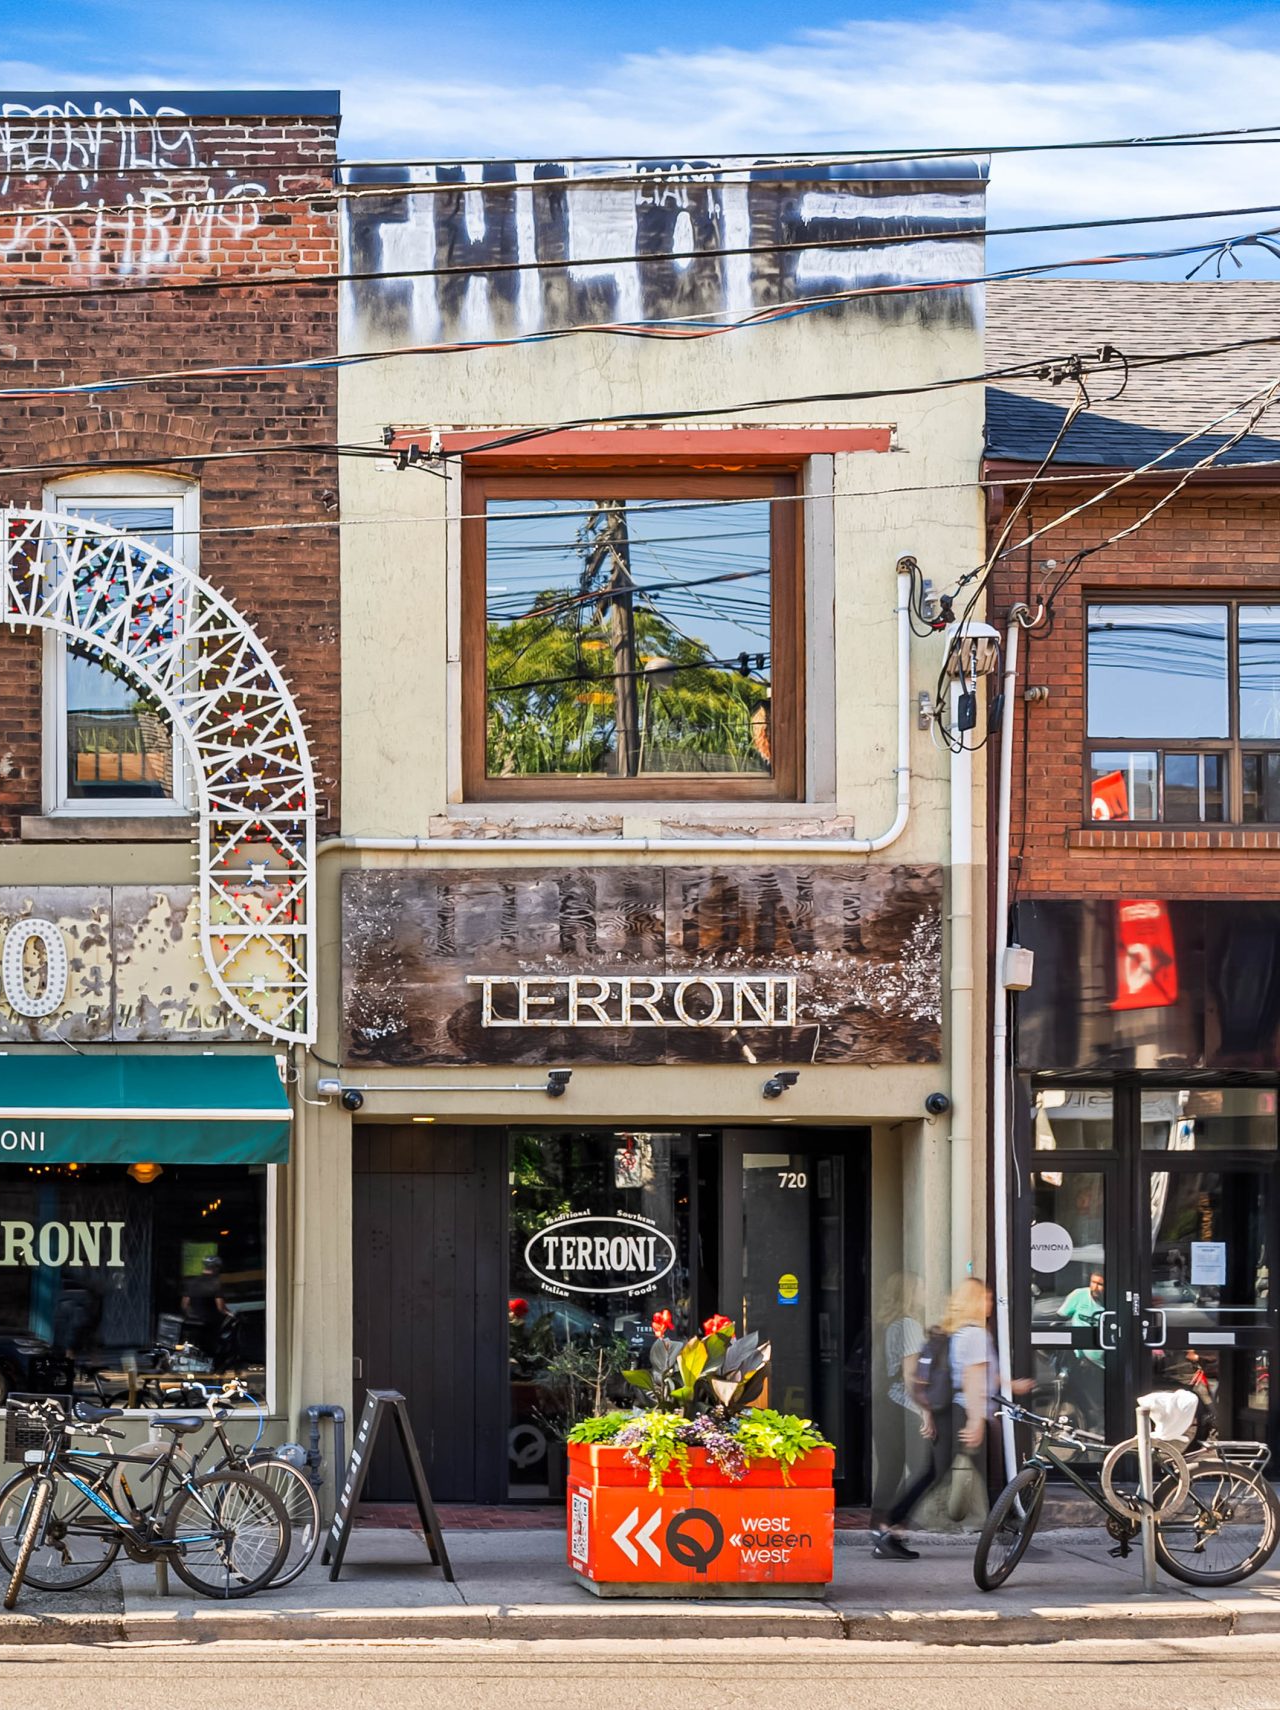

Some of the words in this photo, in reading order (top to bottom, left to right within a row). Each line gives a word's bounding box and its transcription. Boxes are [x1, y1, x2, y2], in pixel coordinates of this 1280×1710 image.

[464, 974, 797, 1028] TERRONI
[777, 1172, 807, 1189] 720
[544, 1208, 592, 1226] Traditional
[616, 1209, 656, 1226] Southern
[543, 1236, 657, 1272] TERRONI
[540, 1281, 570, 1298] Italian
[628, 1283, 658, 1298] Foods
[741, 1516, 790, 1532] west
[665, 1507, 724, 1574] Q
[740, 1548, 791, 1564] west
